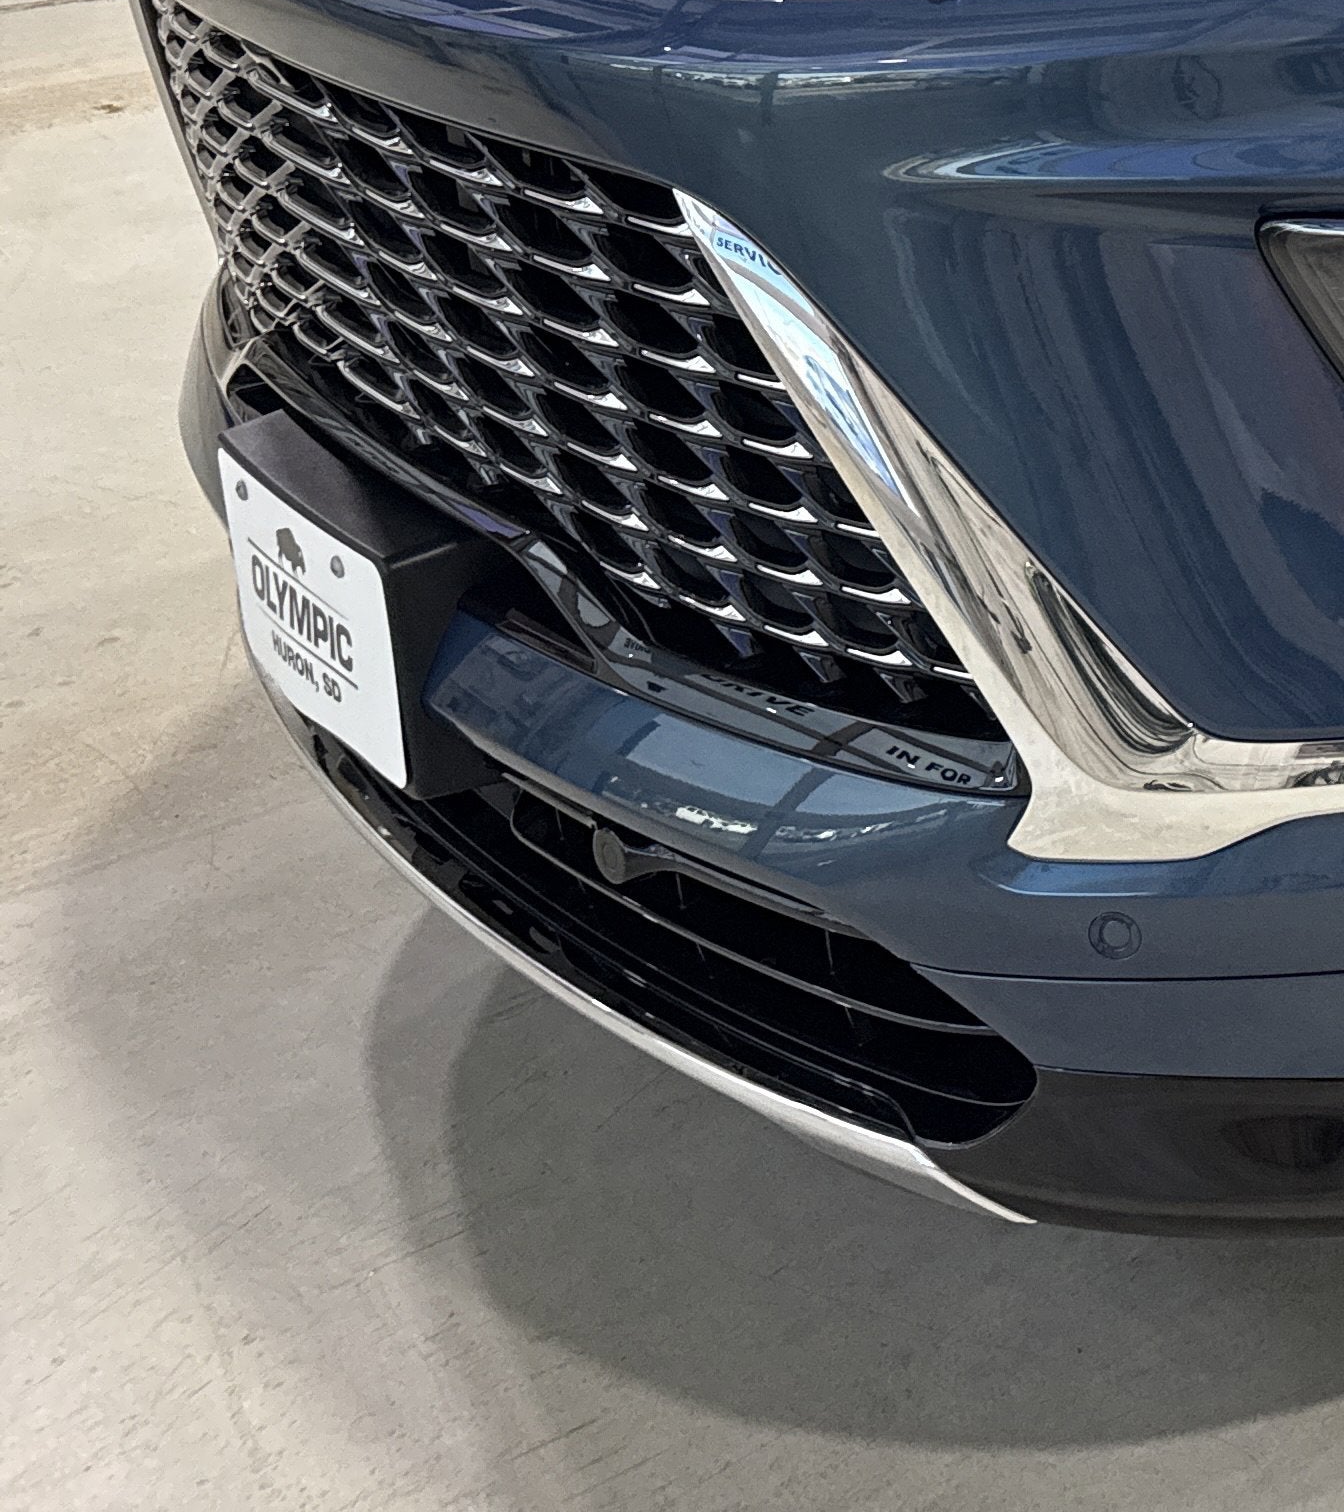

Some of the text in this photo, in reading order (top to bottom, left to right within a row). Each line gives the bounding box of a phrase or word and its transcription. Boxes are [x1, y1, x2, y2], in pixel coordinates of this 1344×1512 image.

[250, 553, 353, 673] OLYMPIC
[271, 630, 342, 703] HURON, SD
[885, 744, 972, 786] IN FOR
